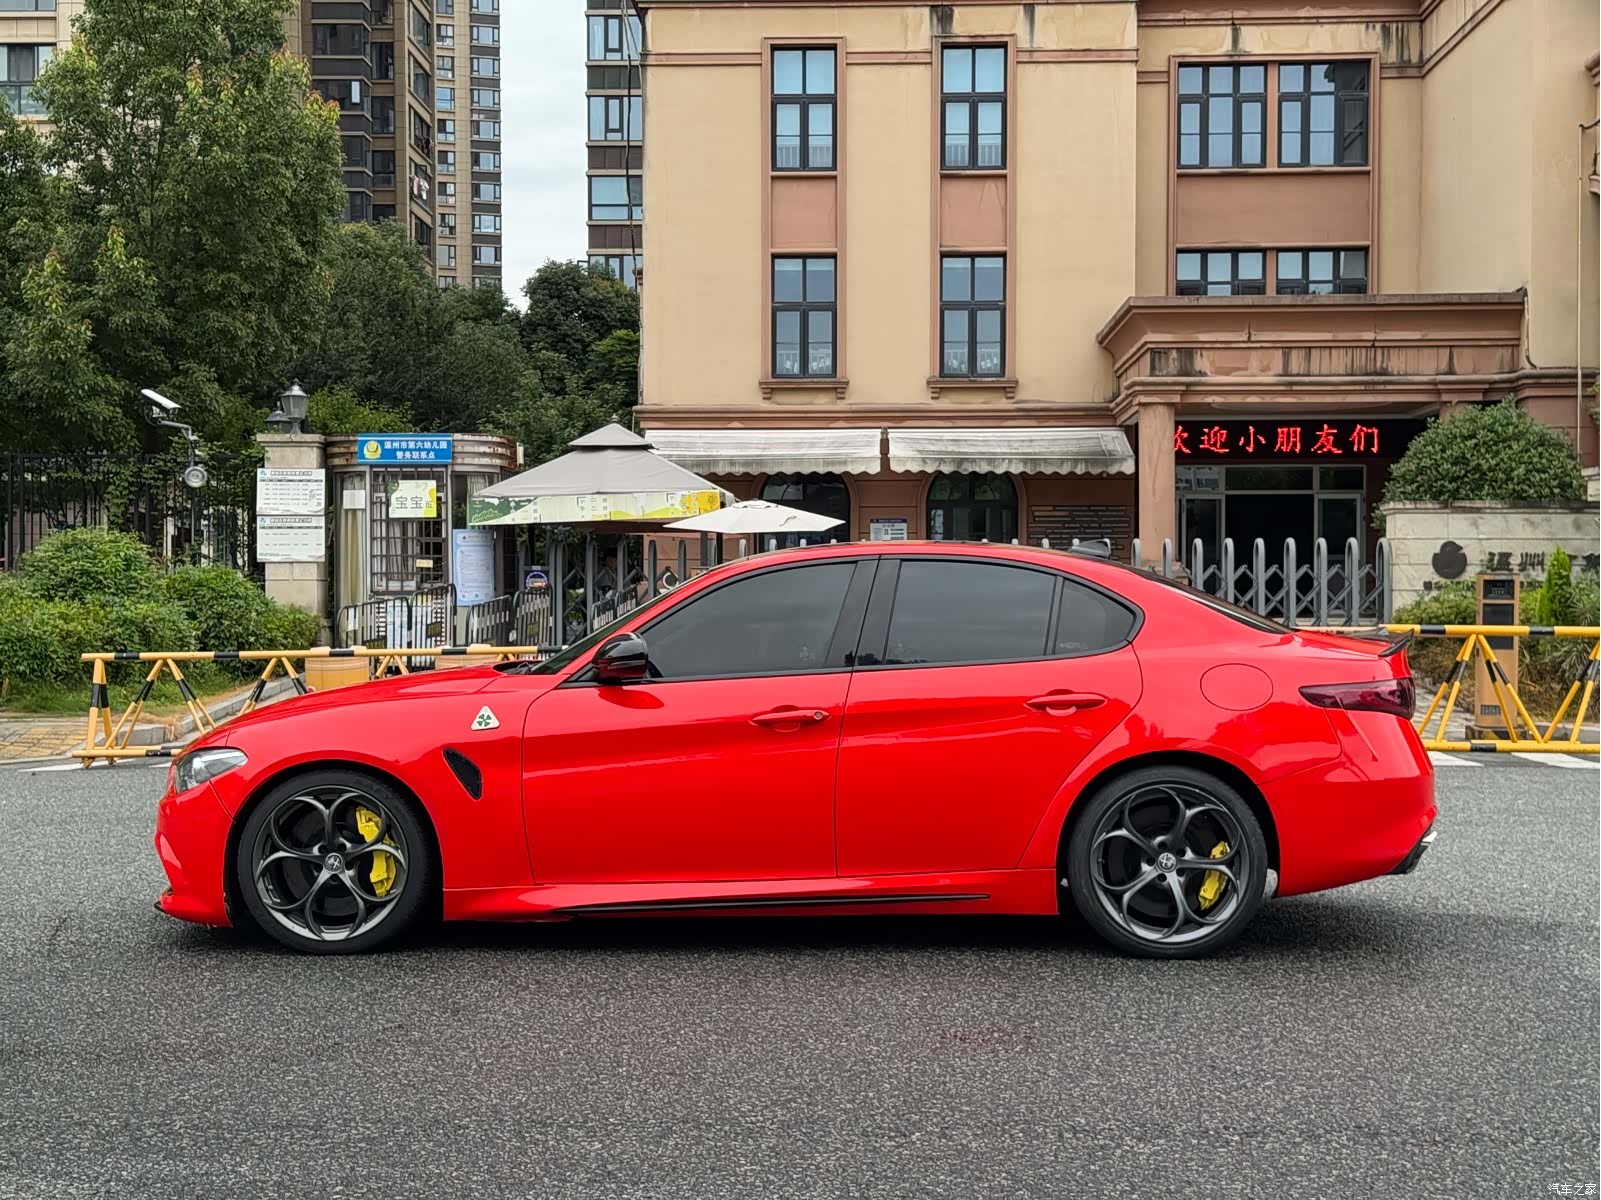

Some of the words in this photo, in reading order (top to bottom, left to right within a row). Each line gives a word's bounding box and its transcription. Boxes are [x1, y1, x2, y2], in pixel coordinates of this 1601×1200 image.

[384, 440, 448, 450] 温州市第六幼儿园
[396, 450, 436, 460] 警务联系点
